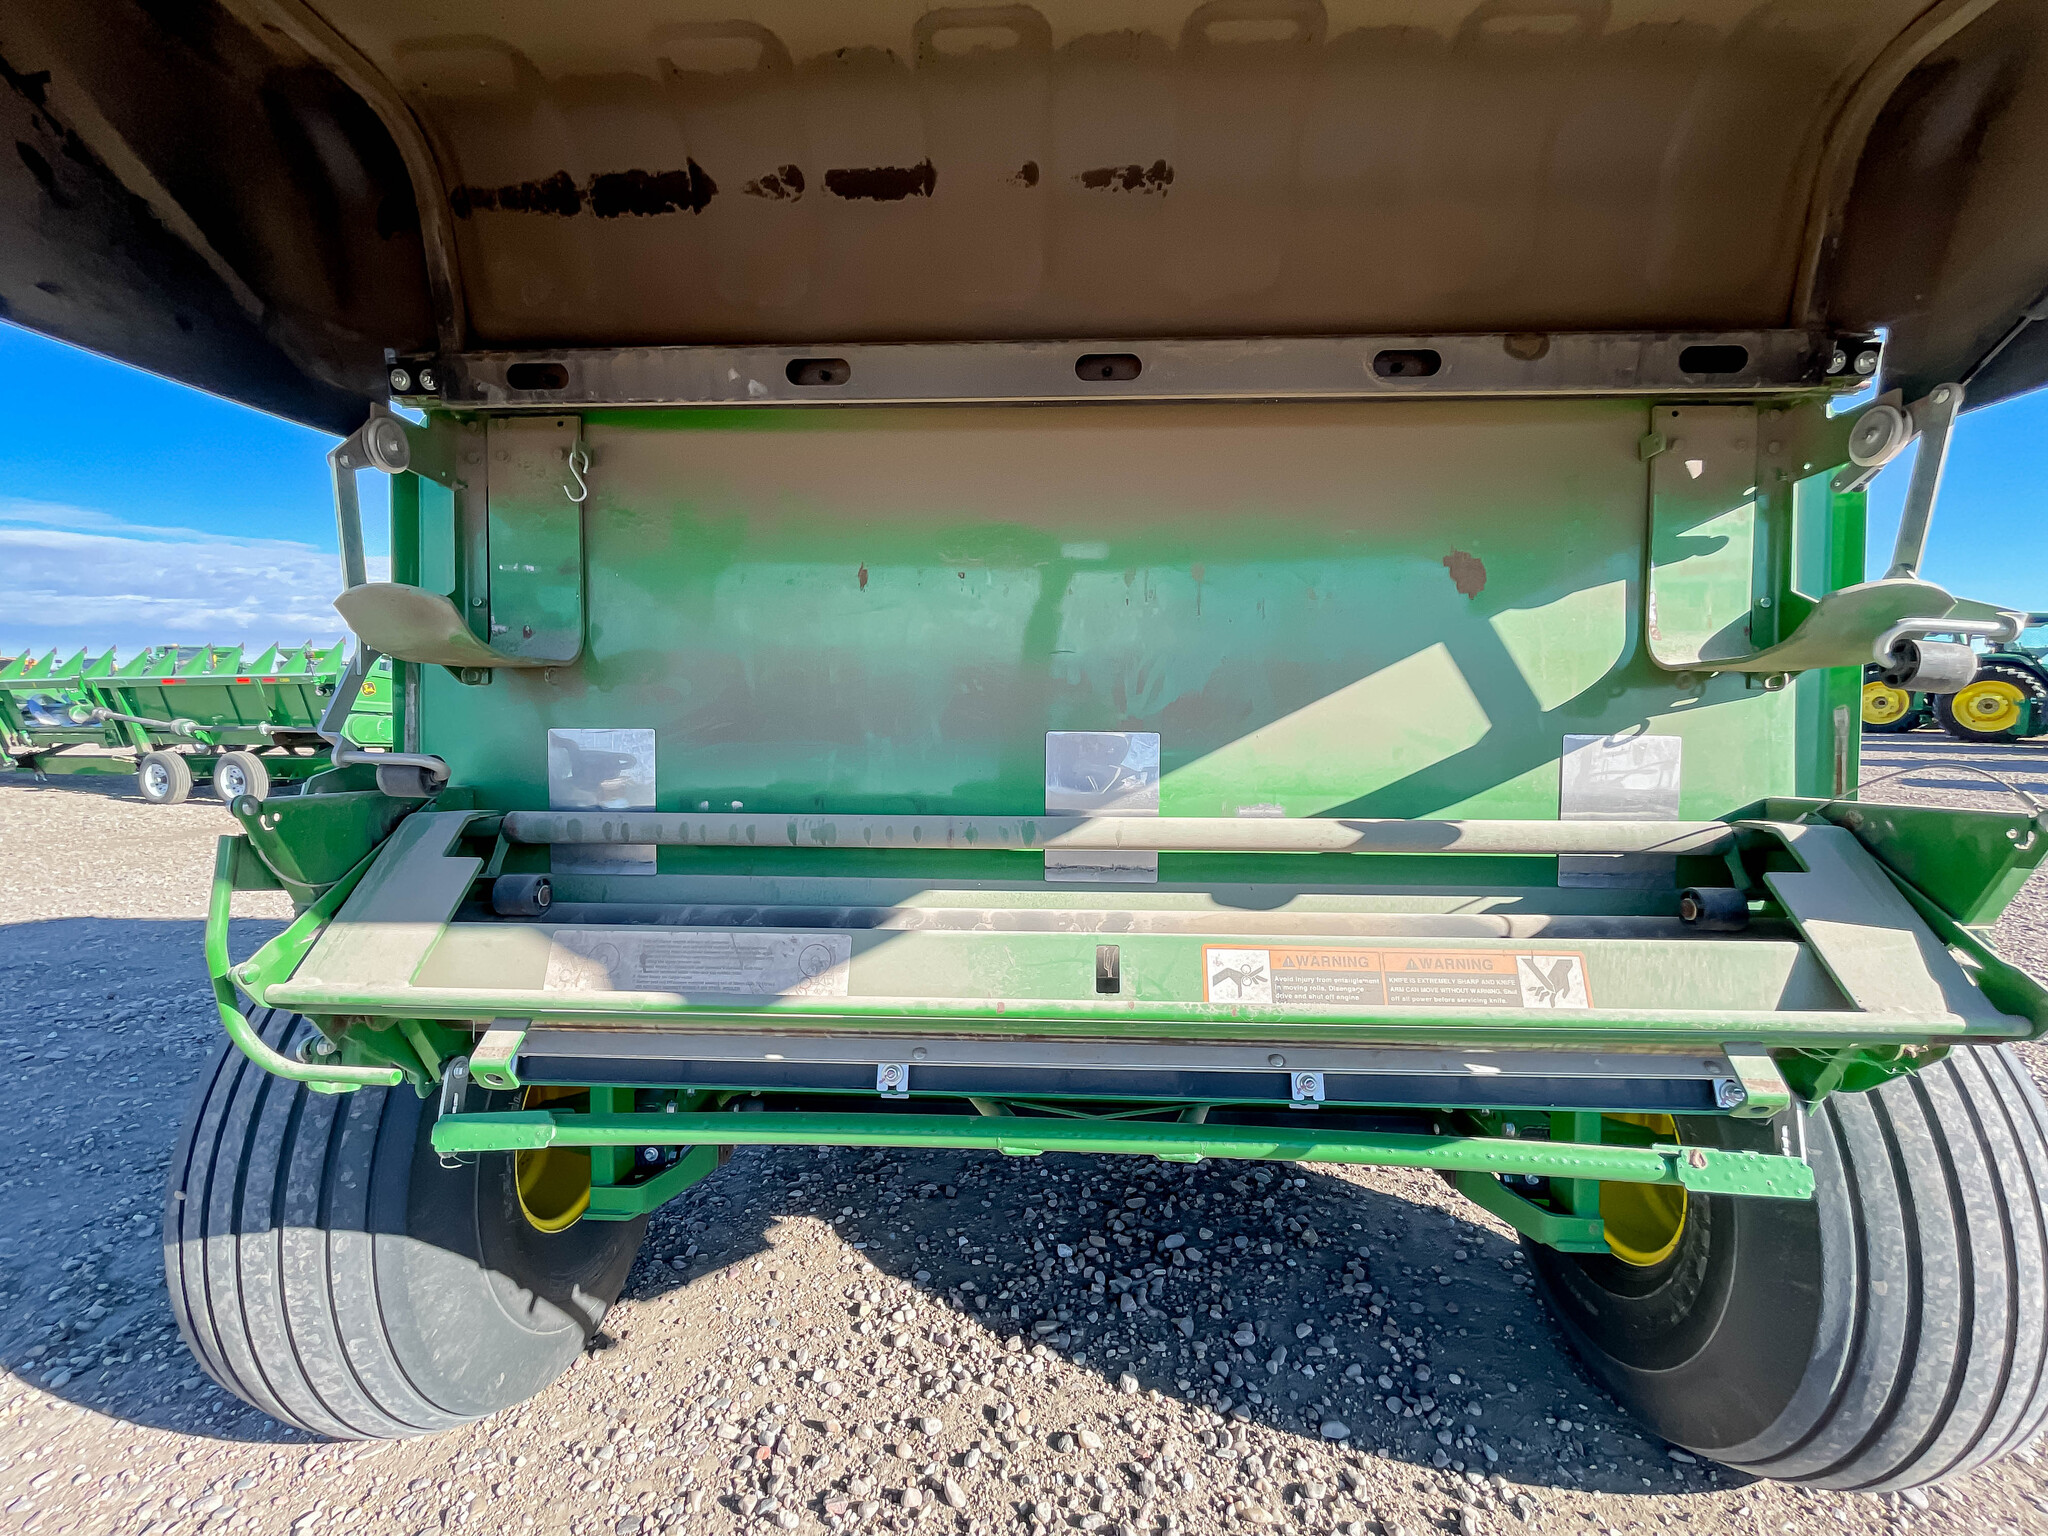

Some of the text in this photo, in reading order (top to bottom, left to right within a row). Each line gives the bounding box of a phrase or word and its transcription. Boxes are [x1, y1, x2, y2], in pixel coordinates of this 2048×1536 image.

[1296, 955, 1369, 968] WARNING
[1418, 957, 1493, 971] WARNING
[1457, 997, 1487, 1005] servicing
